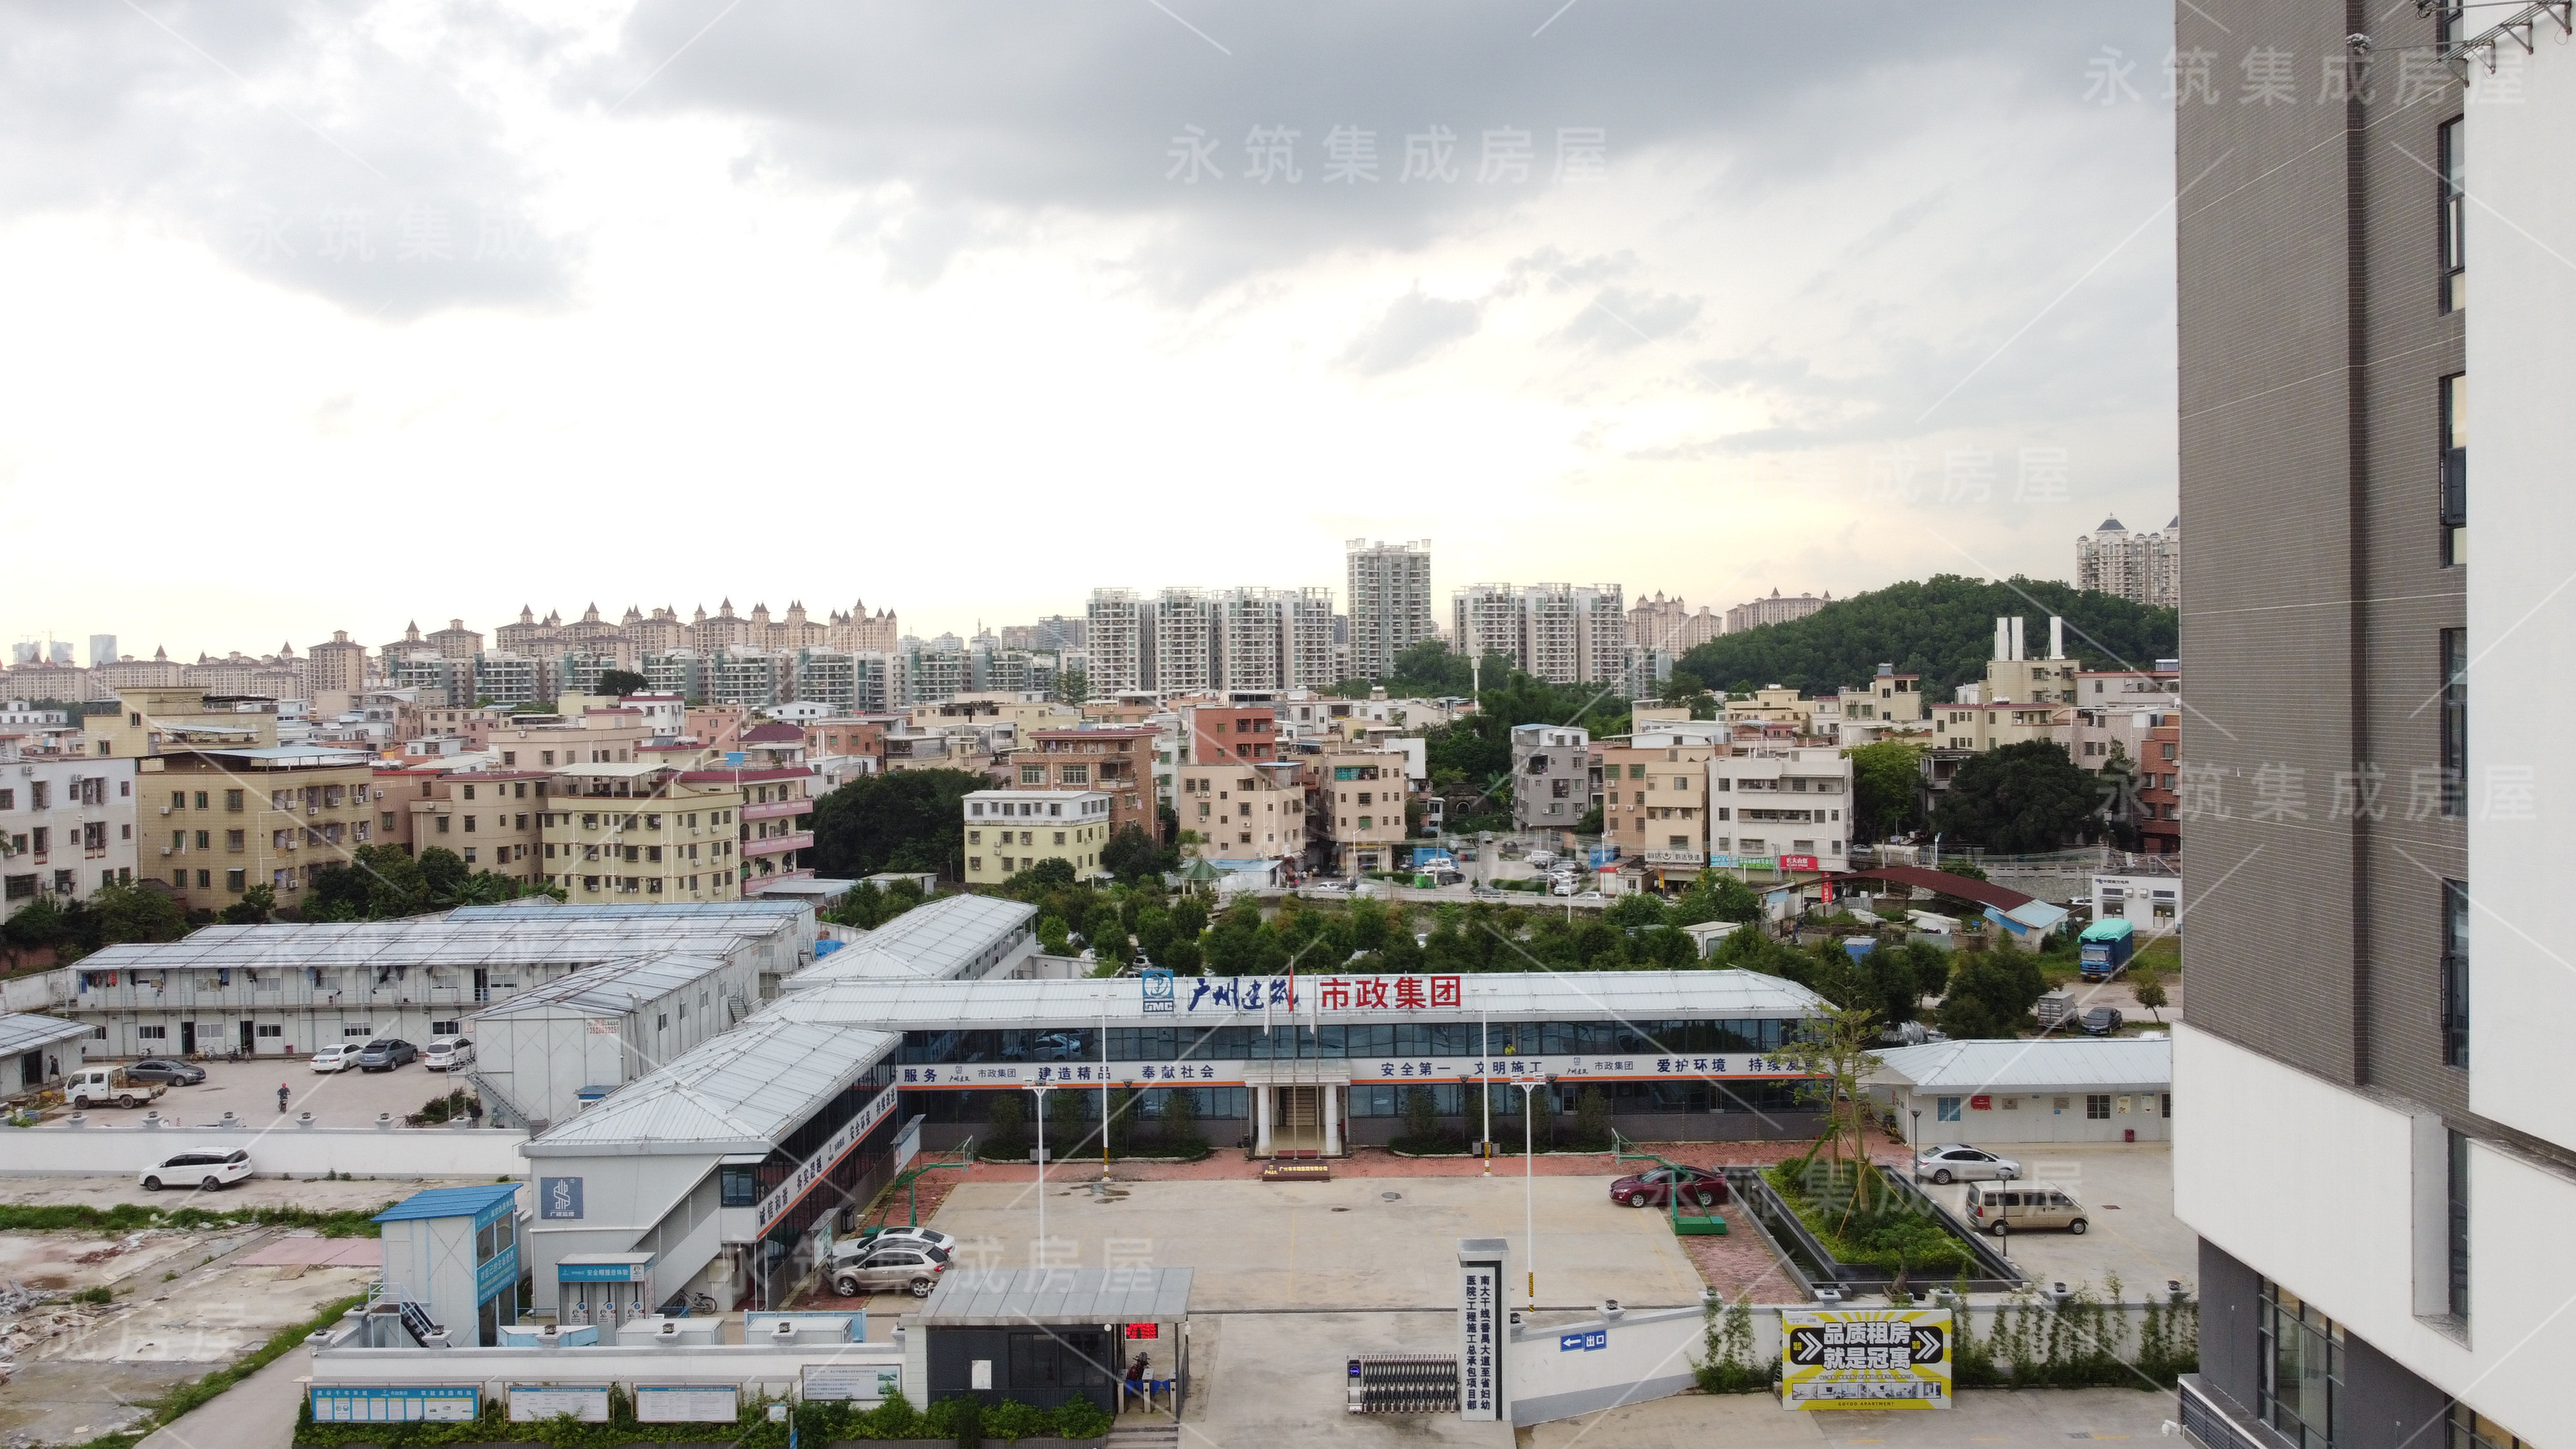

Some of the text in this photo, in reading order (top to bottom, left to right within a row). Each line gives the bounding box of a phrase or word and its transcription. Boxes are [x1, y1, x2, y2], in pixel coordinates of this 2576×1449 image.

[1320, 976, 1461, 1010] 市政集团
[1144, 1002, 1173, 1011] GMC
[904, 1068, 938, 1083] 服务
[978, 1068, 1016, 1078] 市政集团
[1038, 1066, 1112, 1081] 建造精品
[1142, 1065, 1215, 1079] 奉献社会
[1381, 1061, 1451, 1077] 安全第一
[1474, 1061, 1543, 1075] 文明施工
[1594, 1061, 1634, 1070] 市政集团
[1657, 1058, 1727, 1072] 爱护环境
[759, 1186, 789, 1227] 诚信和谐
[796, 1154, 823, 1193] 务实超越
[849, 1110, 871, 1141] 安全环保
[876, 1087, 896, 1116] 持续改进
[1466, 1275, 1477, 1410] 医院)工程施工总承包项目部
[1479, 1275, 1491, 1410] 南大干线(番禺大道至省妇幼
[1586, 1335, 1604, 1347] 出口
[1824, 1321, 1911, 1345] 品质租房
[1823, 1347, 1911, 1370] 就是冠寓
